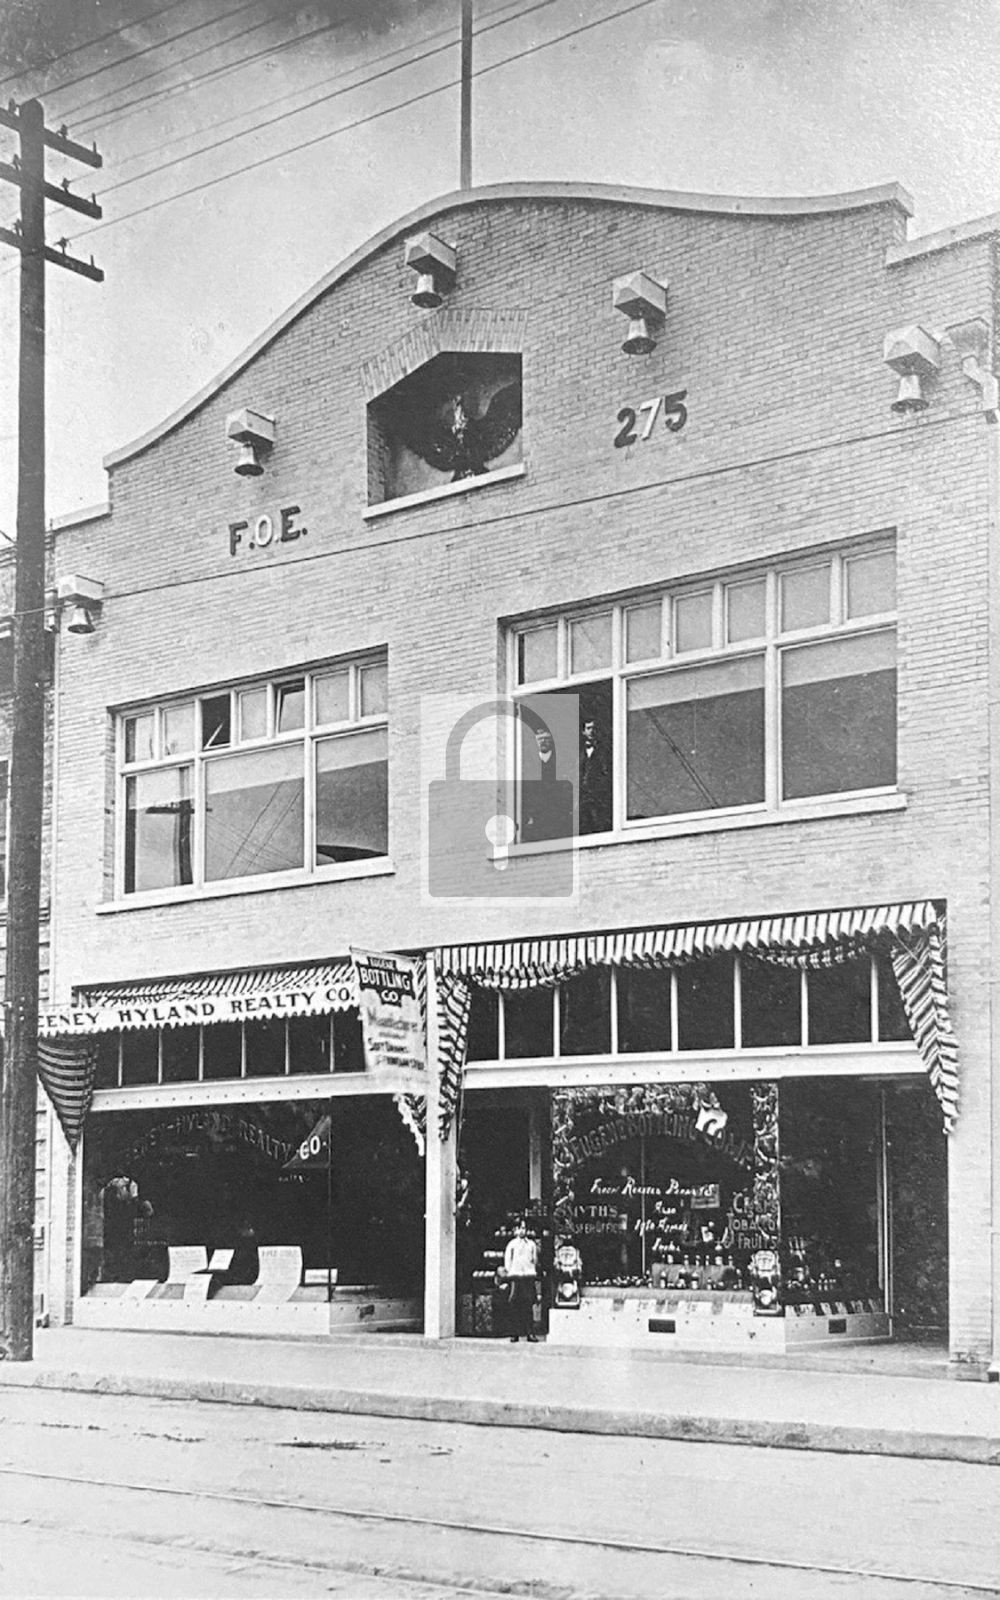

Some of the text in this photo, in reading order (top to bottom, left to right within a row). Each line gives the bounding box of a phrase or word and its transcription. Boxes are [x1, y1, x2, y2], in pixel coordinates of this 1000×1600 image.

[613, 389, 688, 448] 275
[228, 506, 308, 556] F.O.E.
[360, 967, 411, 991] BOTTLING
[118, 1002, 215, 1023] HYLAND
[231, 991, 316, 1014] REALTY
[326, 986, 355, 1001] CO.
